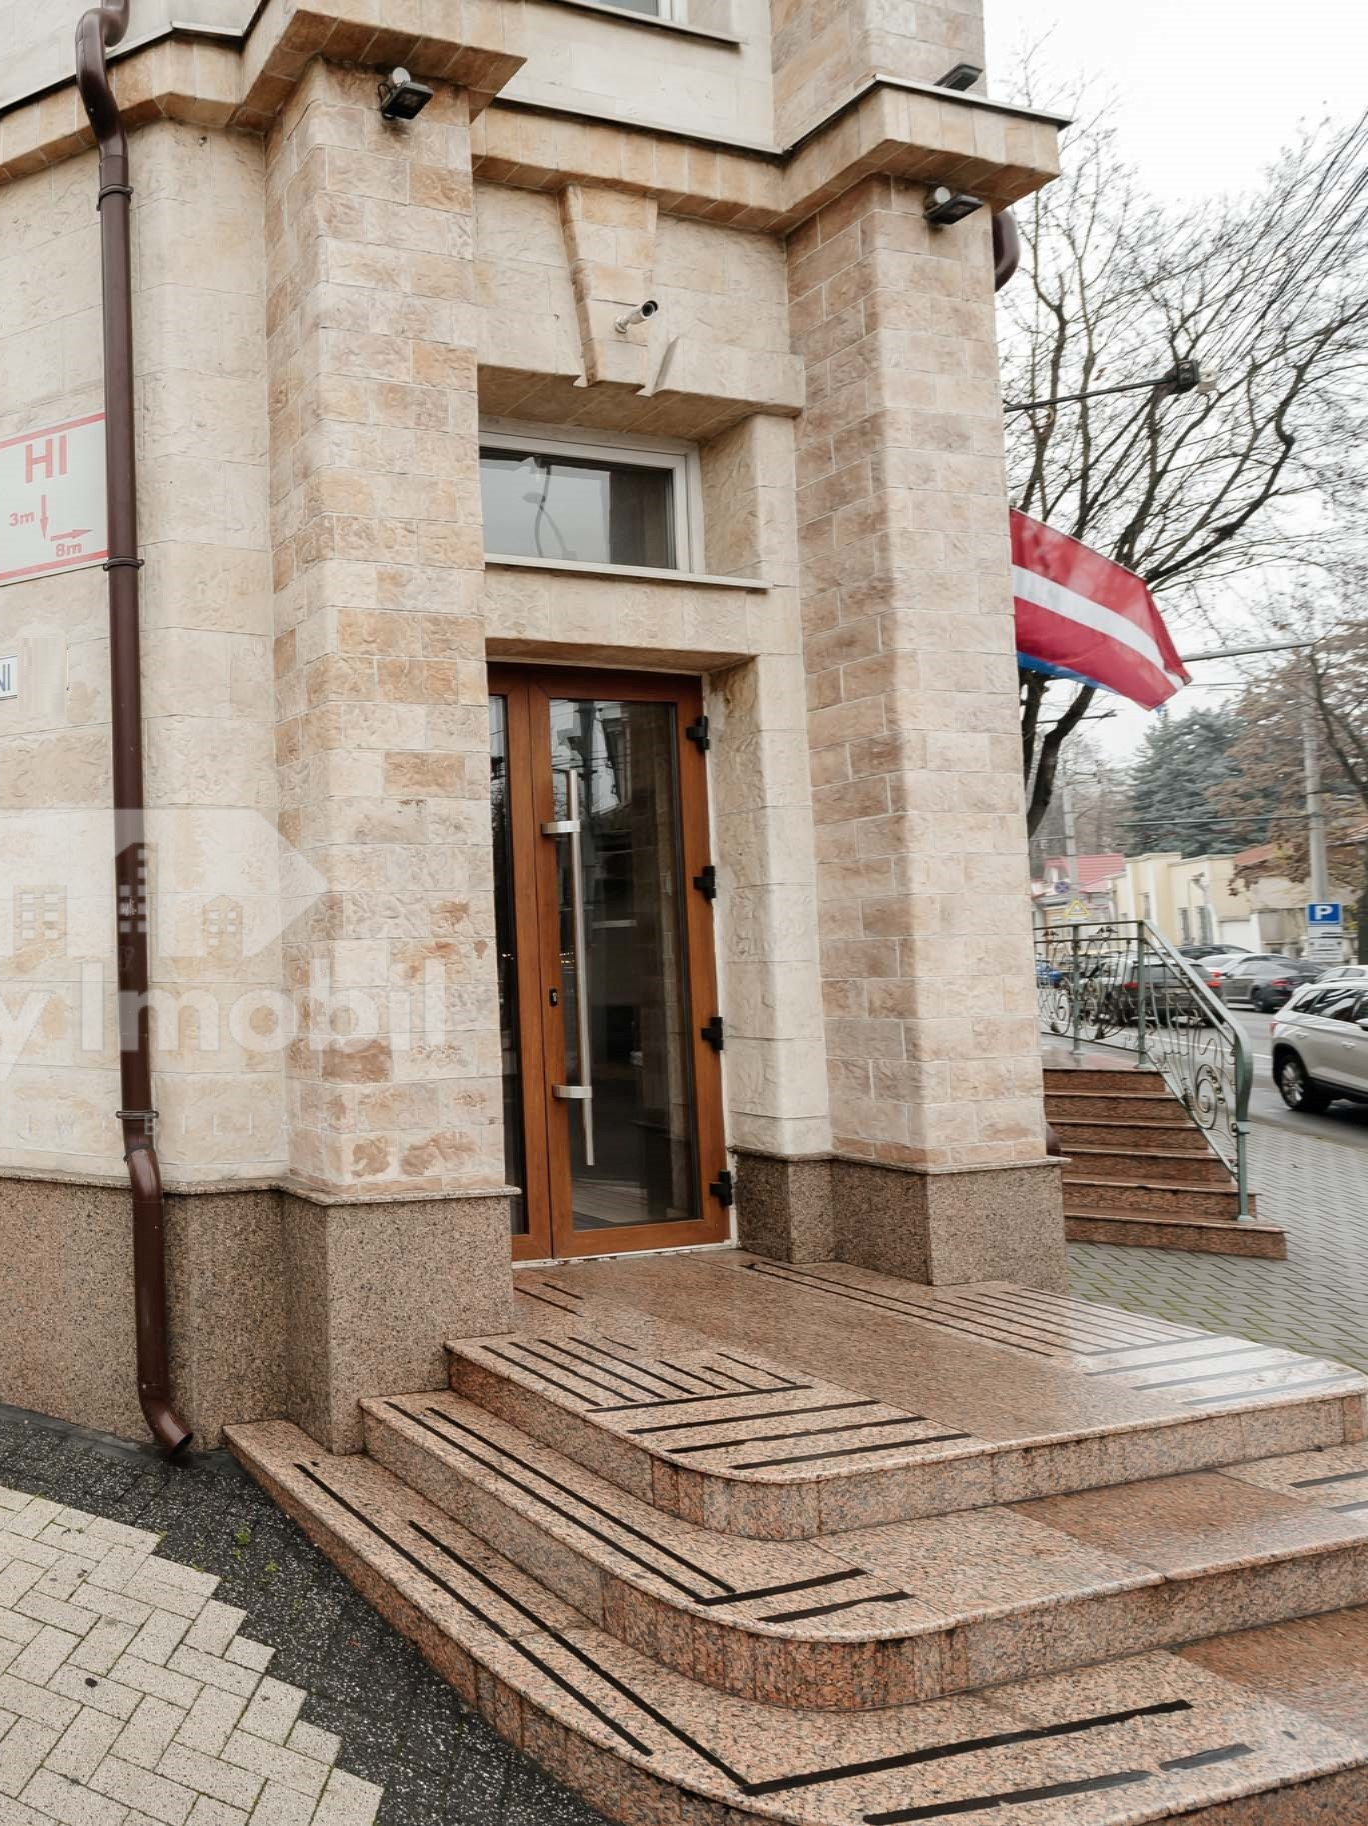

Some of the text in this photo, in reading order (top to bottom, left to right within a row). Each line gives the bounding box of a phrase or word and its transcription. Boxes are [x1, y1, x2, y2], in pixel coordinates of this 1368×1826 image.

[25, 435, 67, 484] HI
[9, 511, 35, 527] 3m
[55, 543, 82, 557] 8m
[1314, 905, 1333, 920] P
